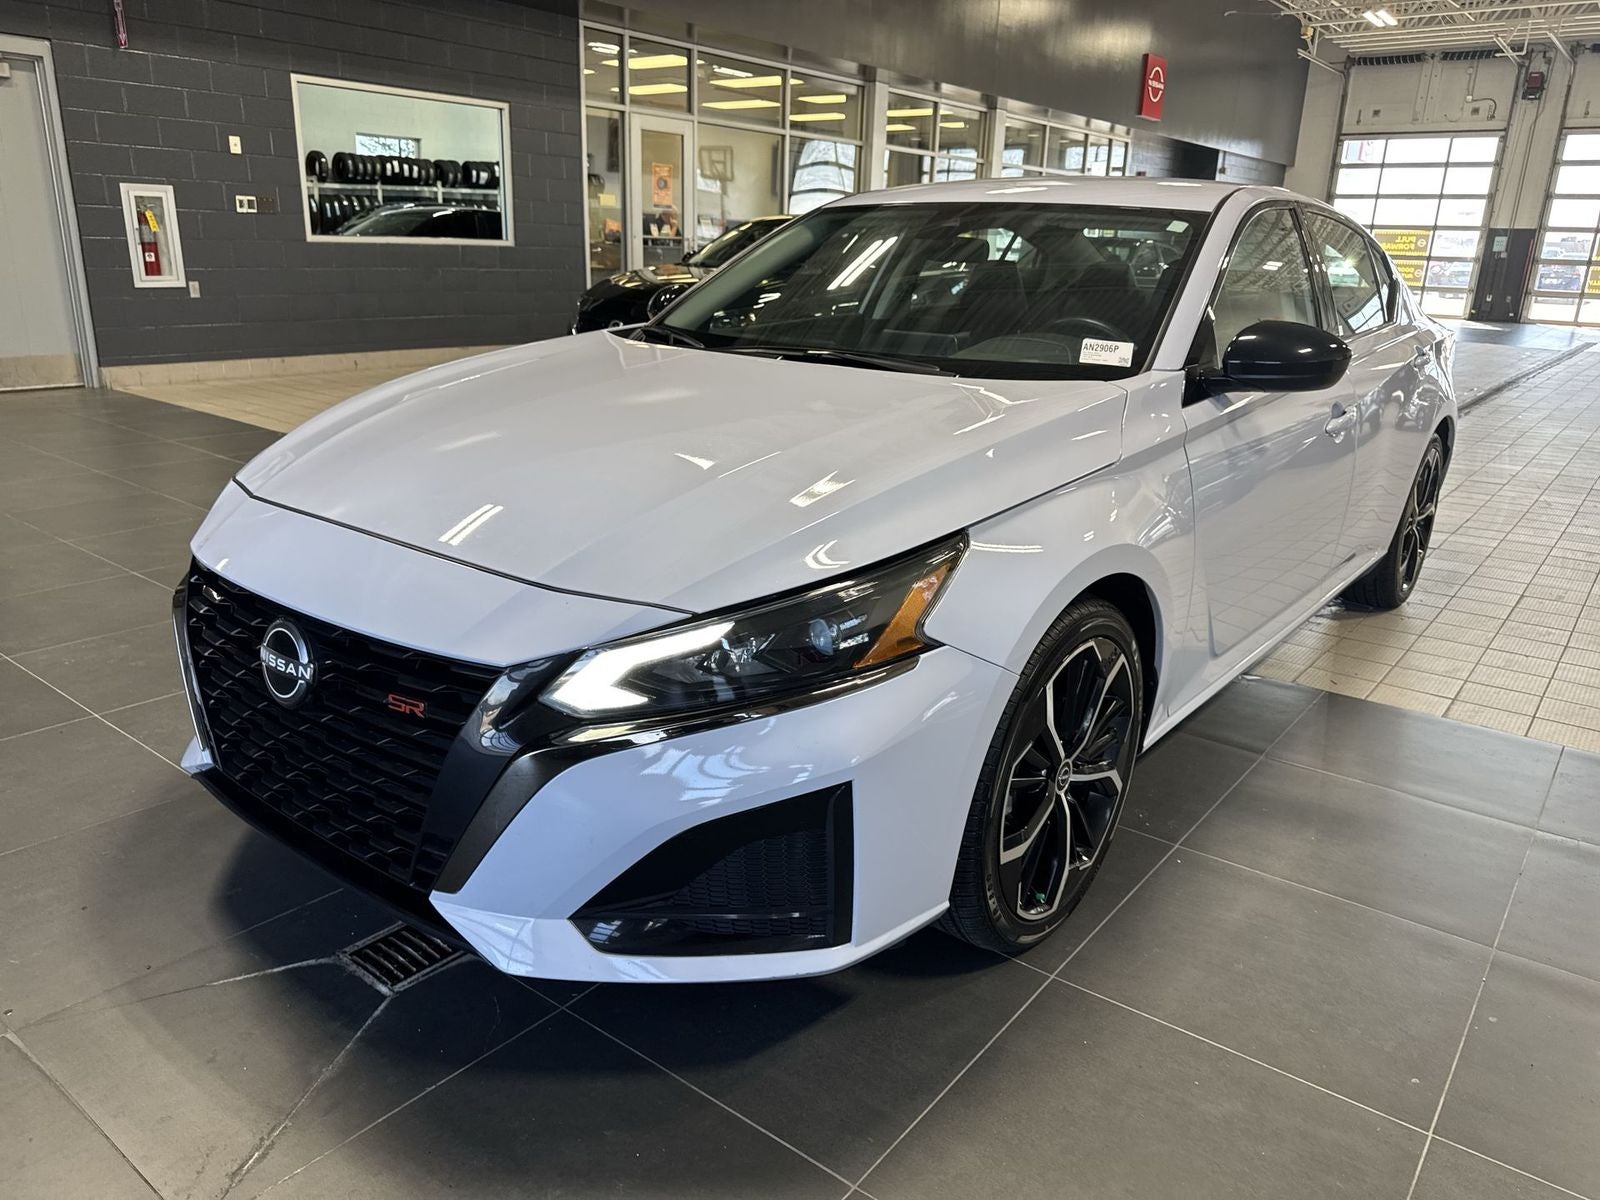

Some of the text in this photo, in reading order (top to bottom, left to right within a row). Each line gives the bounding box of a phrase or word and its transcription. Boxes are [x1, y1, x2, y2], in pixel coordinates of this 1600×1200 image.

[1083, 343, 1119, 353] AN2906P
[261, 646, 311, 680] NISSAN
[387, 693, 425, 718] SR
